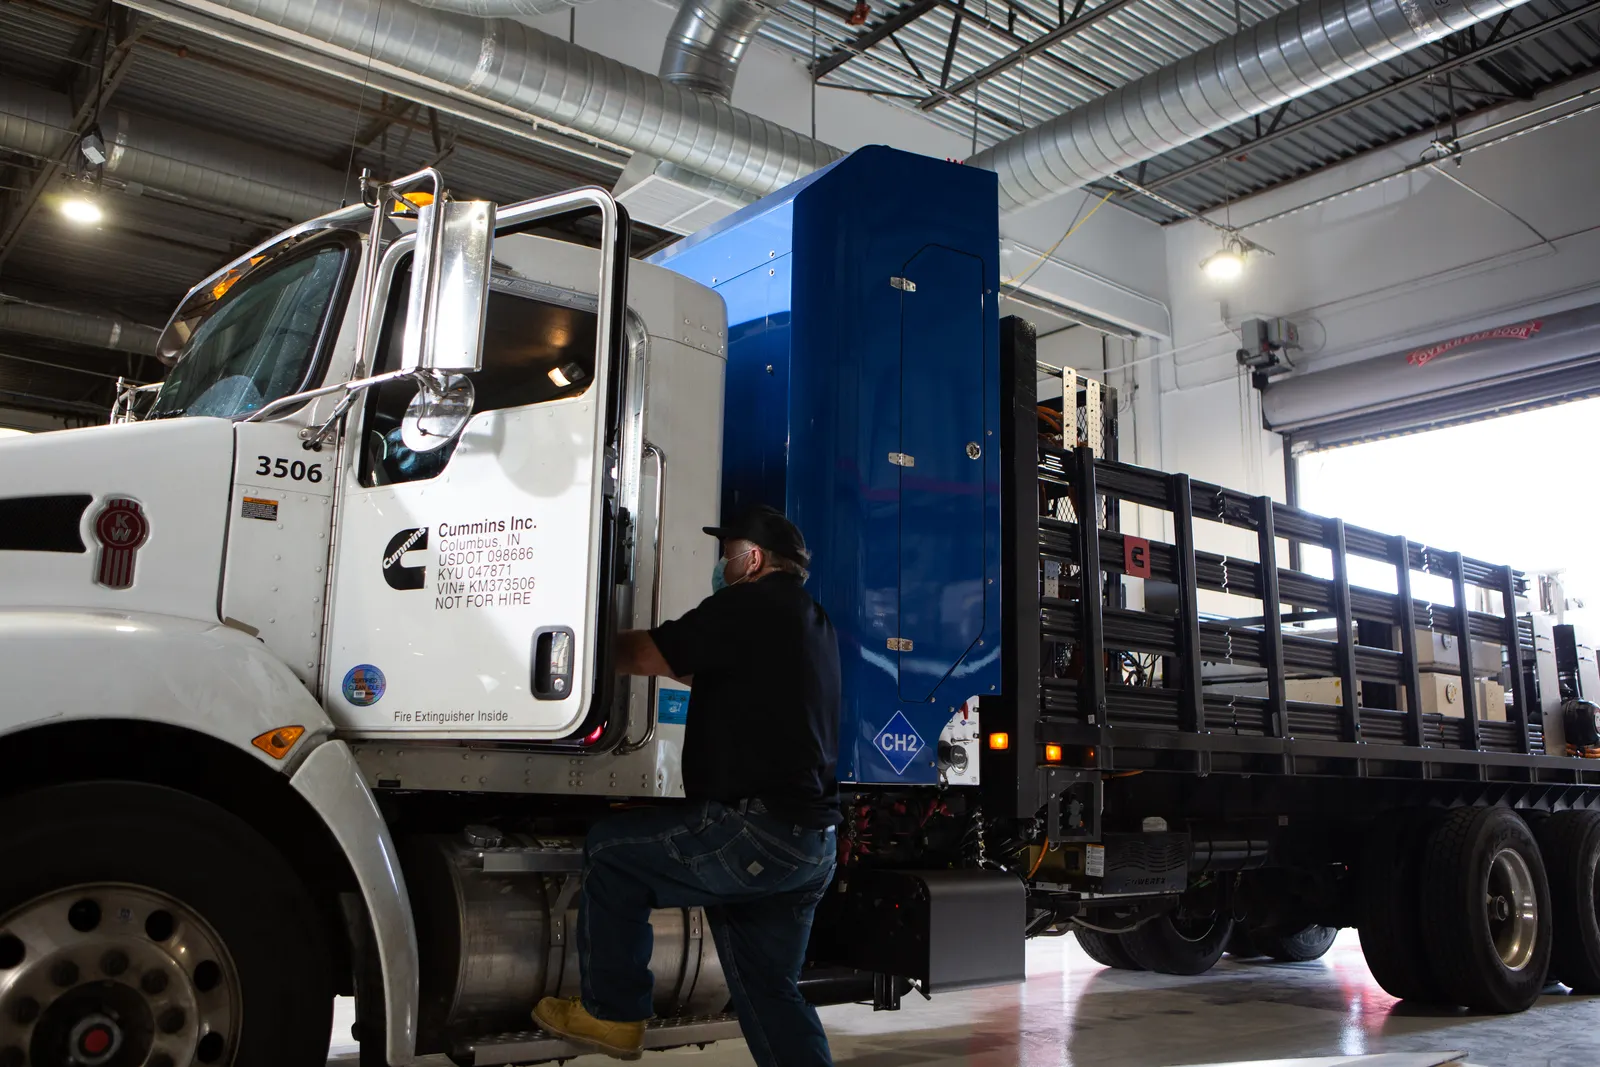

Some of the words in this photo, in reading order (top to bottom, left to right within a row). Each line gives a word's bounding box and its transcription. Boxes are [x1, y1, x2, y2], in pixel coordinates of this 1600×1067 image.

[1418, 331, 1490, 362] OVERHEAD
[1493, 326, 1528, 337] DOOR
[256, 455, 323, 483] 3506
[438, 518, 506, 538] Cummins
[510, 515, 537, 531] Inc.
[383, 527, 426, 570] Cummins
[507, 533, 520, 546] IN
[438, 551, 483, 566] USDOT
[487, 547, 534, 562] 098686
[437, 567, 464, 581] KYU
[468, 564, 512, 579] 047871
[437, 581, 465, 595] VIN#
[469, 577, 535, 593] KM373506
[435, 595, 462, 610] NOT
[466, 594, 494, 608] FOR
[498, 591, 532, 606] HIRE
[394, 711, 411, 722] Fire
[415, 710, 474, 725] Extinguisher
[477, 710, 509, 722] Inside
[881, 733, 918, 752] CH2
